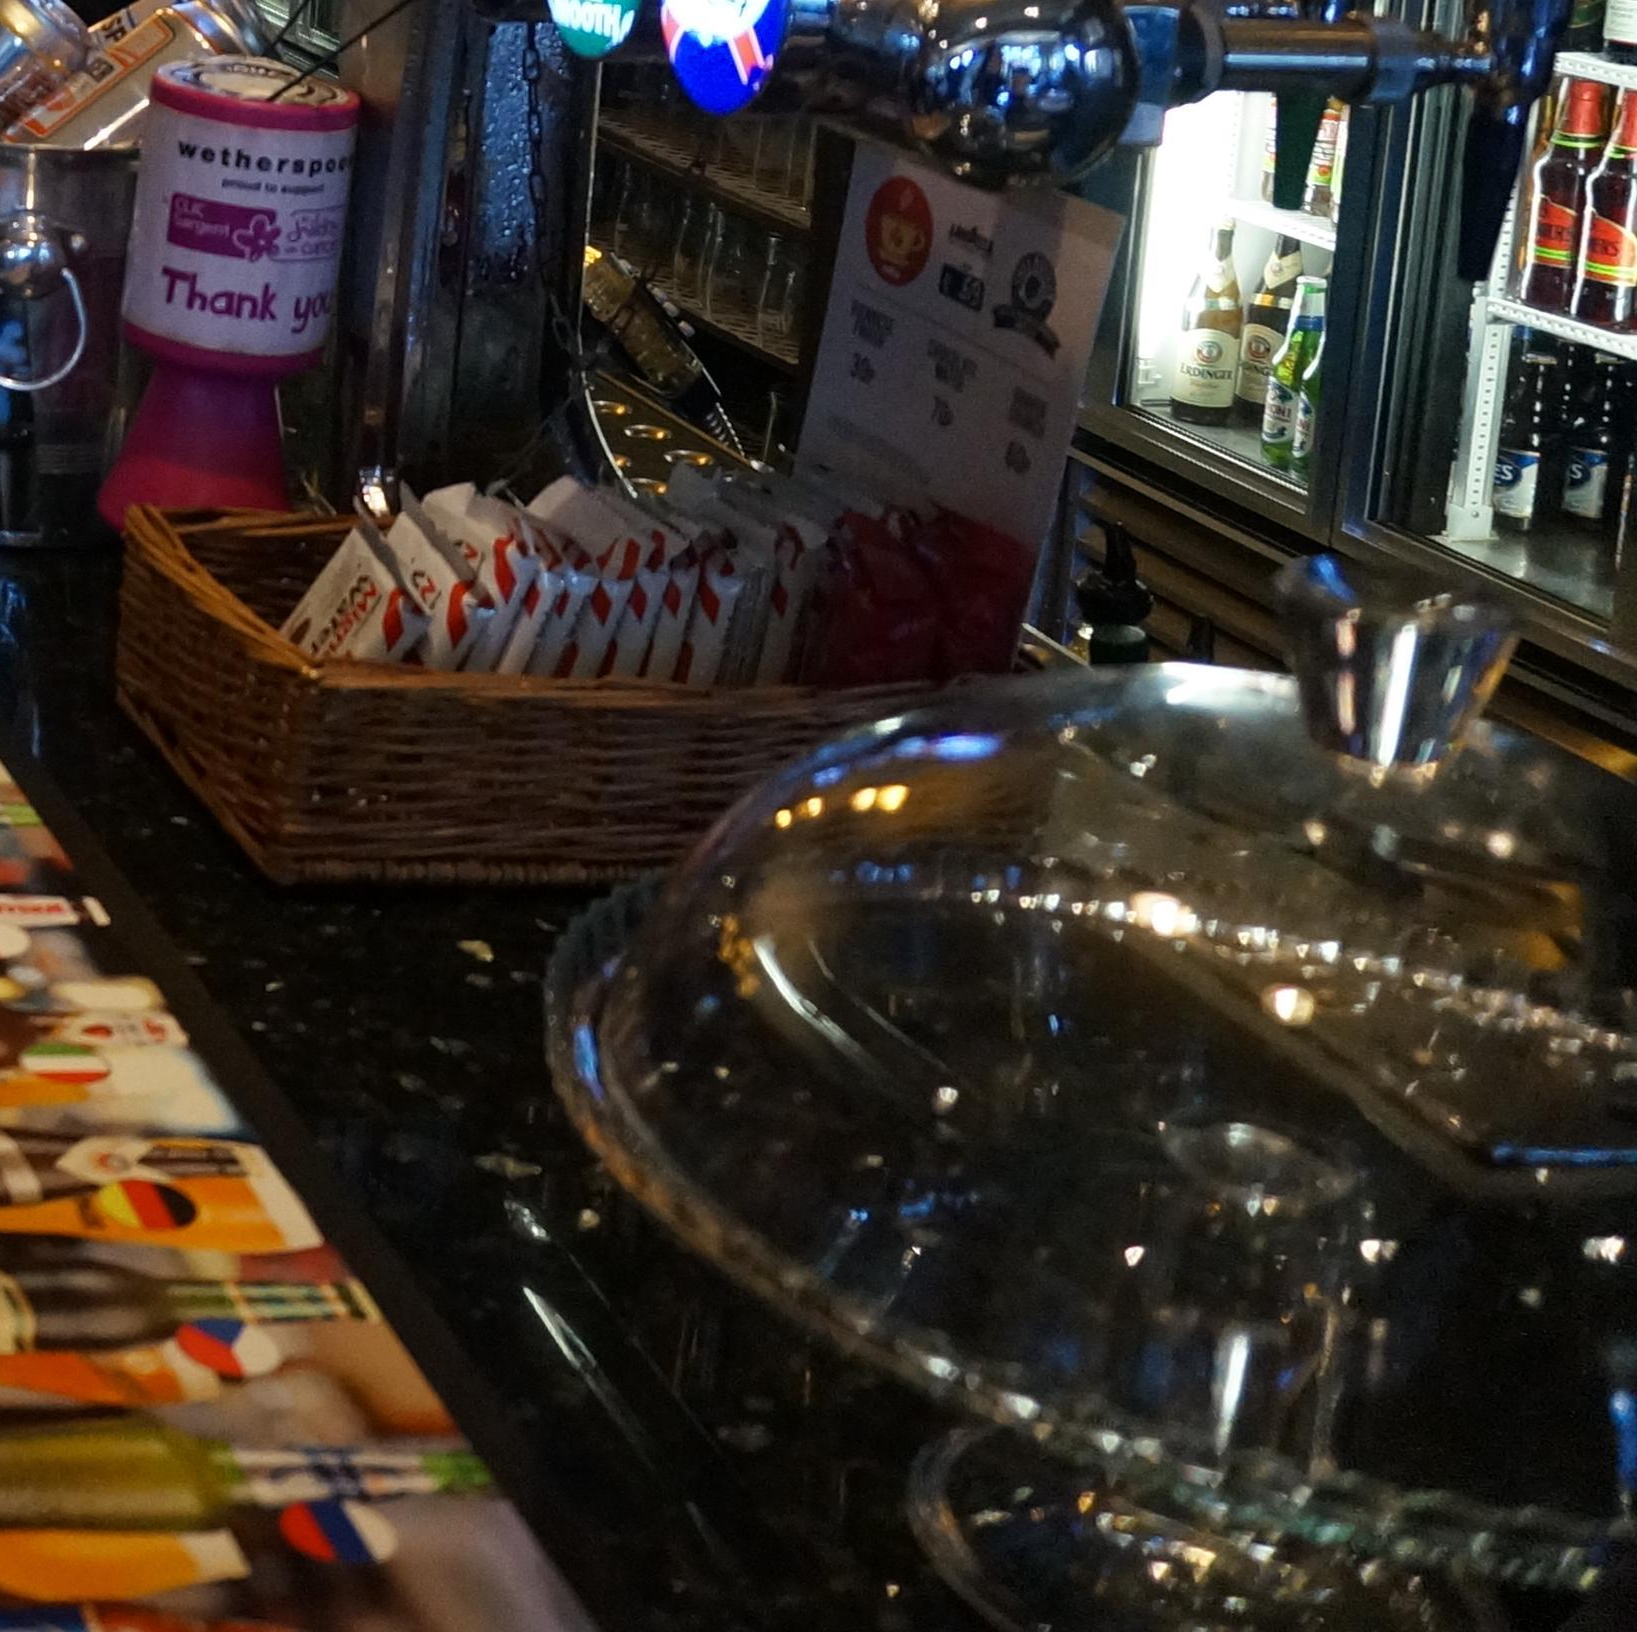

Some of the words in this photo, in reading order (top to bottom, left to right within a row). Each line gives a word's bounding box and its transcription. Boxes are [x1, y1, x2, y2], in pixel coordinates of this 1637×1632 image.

[162, 265, 276, 321] Thank
[291, 289, 332, 334] yo
[1180, 362, 1233, 381] ERDINGER
